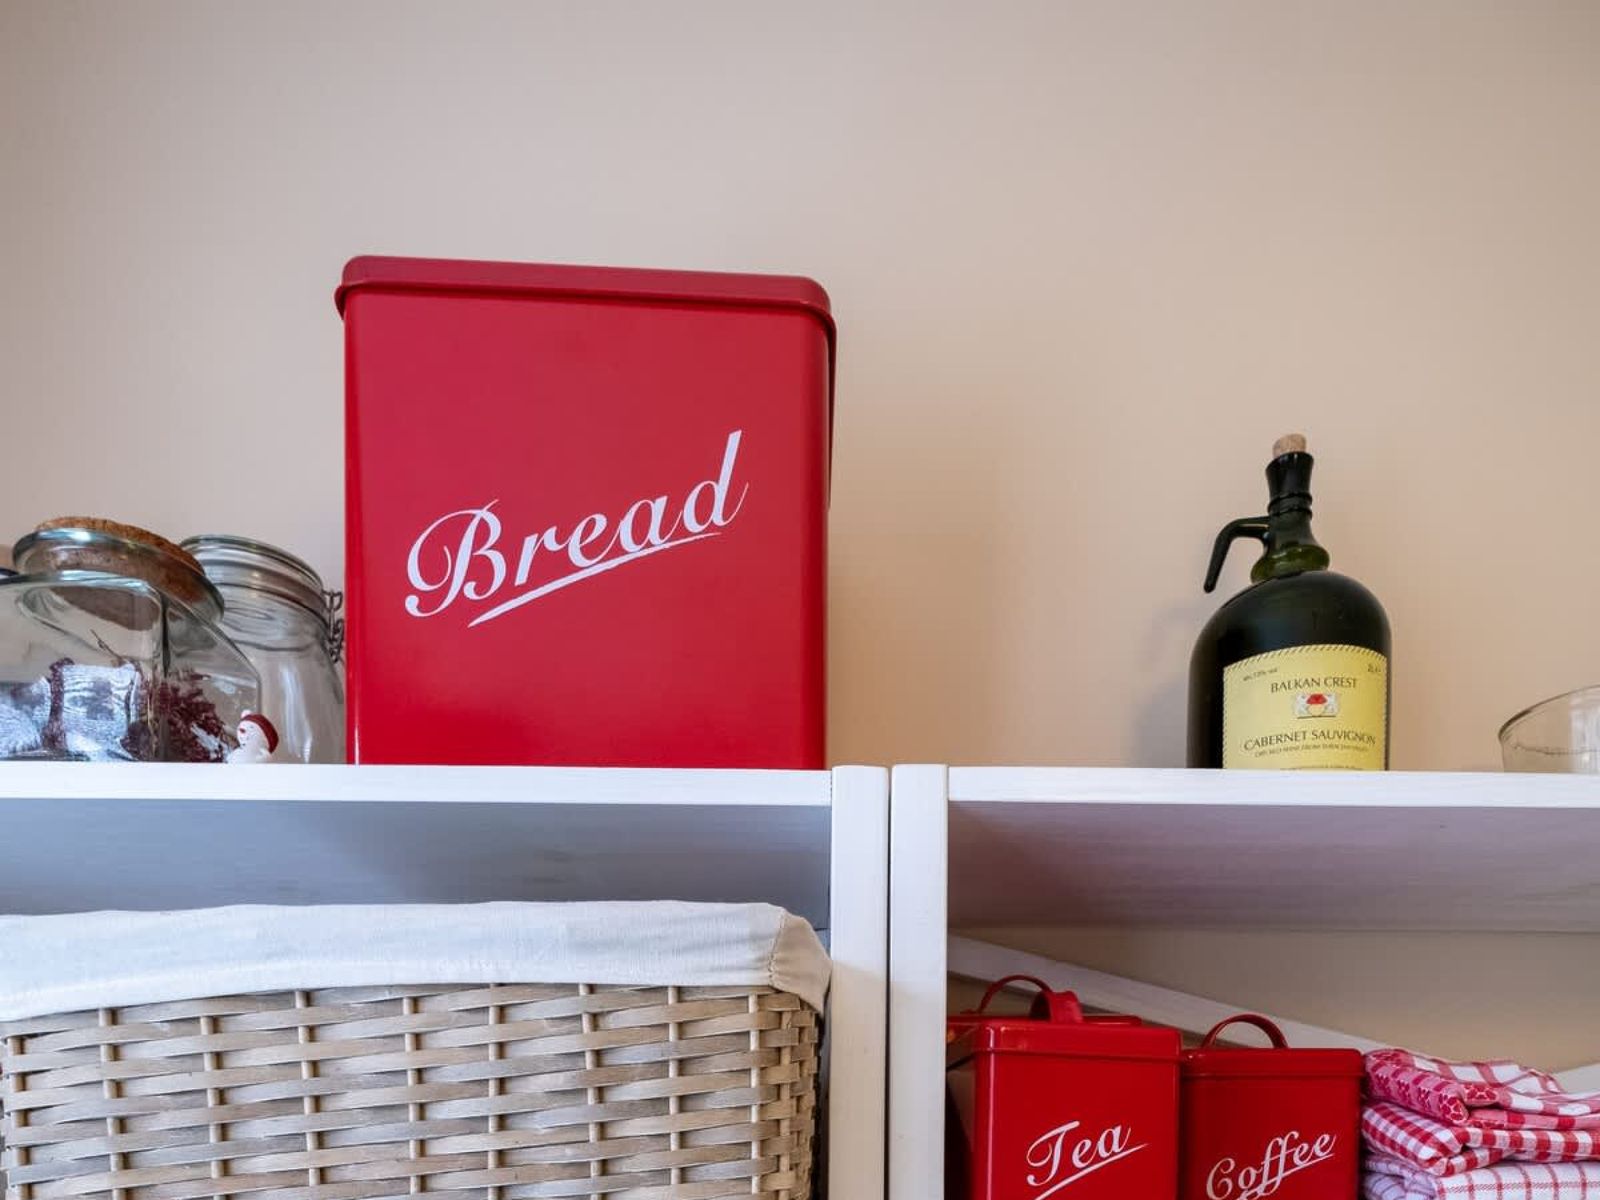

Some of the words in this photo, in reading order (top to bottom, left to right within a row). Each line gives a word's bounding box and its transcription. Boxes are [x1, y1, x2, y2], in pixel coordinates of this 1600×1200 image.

[404, 429, 749, 618] Bread
[1270, 677, 1320, 693] BALKAN
[1323, 676, 1357, 689] CREST
[1243, 730, 1306, 751] CABERNET
[1311, 729, 1376, 745] SAUVIGNON
[1026, 1119, 1133, 1188] Tea
